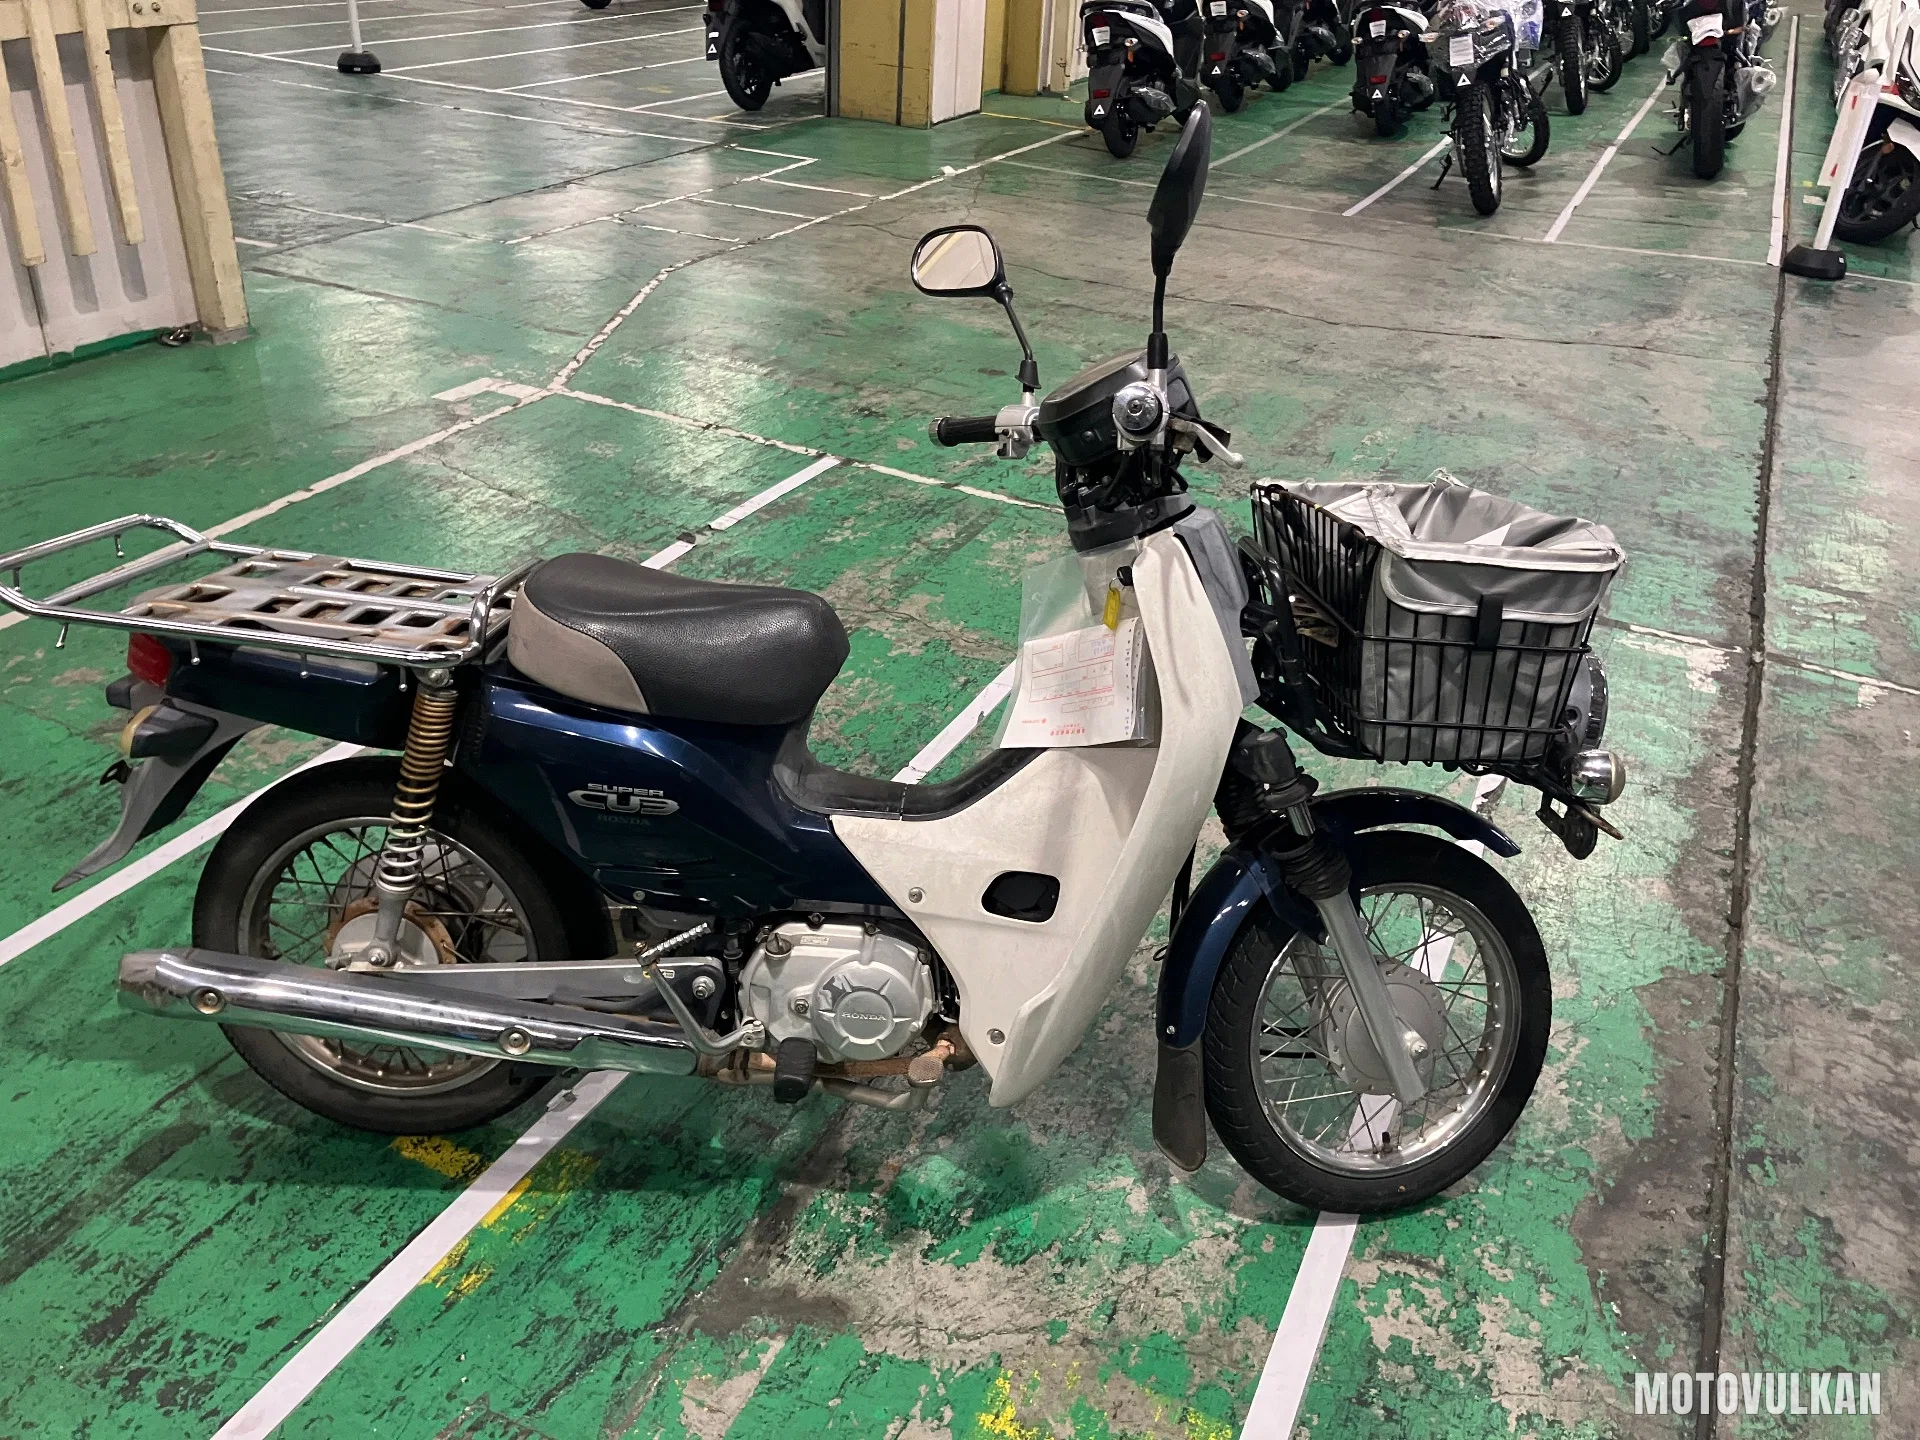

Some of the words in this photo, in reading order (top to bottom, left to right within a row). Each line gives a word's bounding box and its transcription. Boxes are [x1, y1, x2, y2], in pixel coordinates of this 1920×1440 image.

[588, 783, 664, 797] SUPER
[567, 789, 680, 816] CUB
[597, 814, 651, 827] HONDA
[841, 1010, 887, 1021] HONDA
